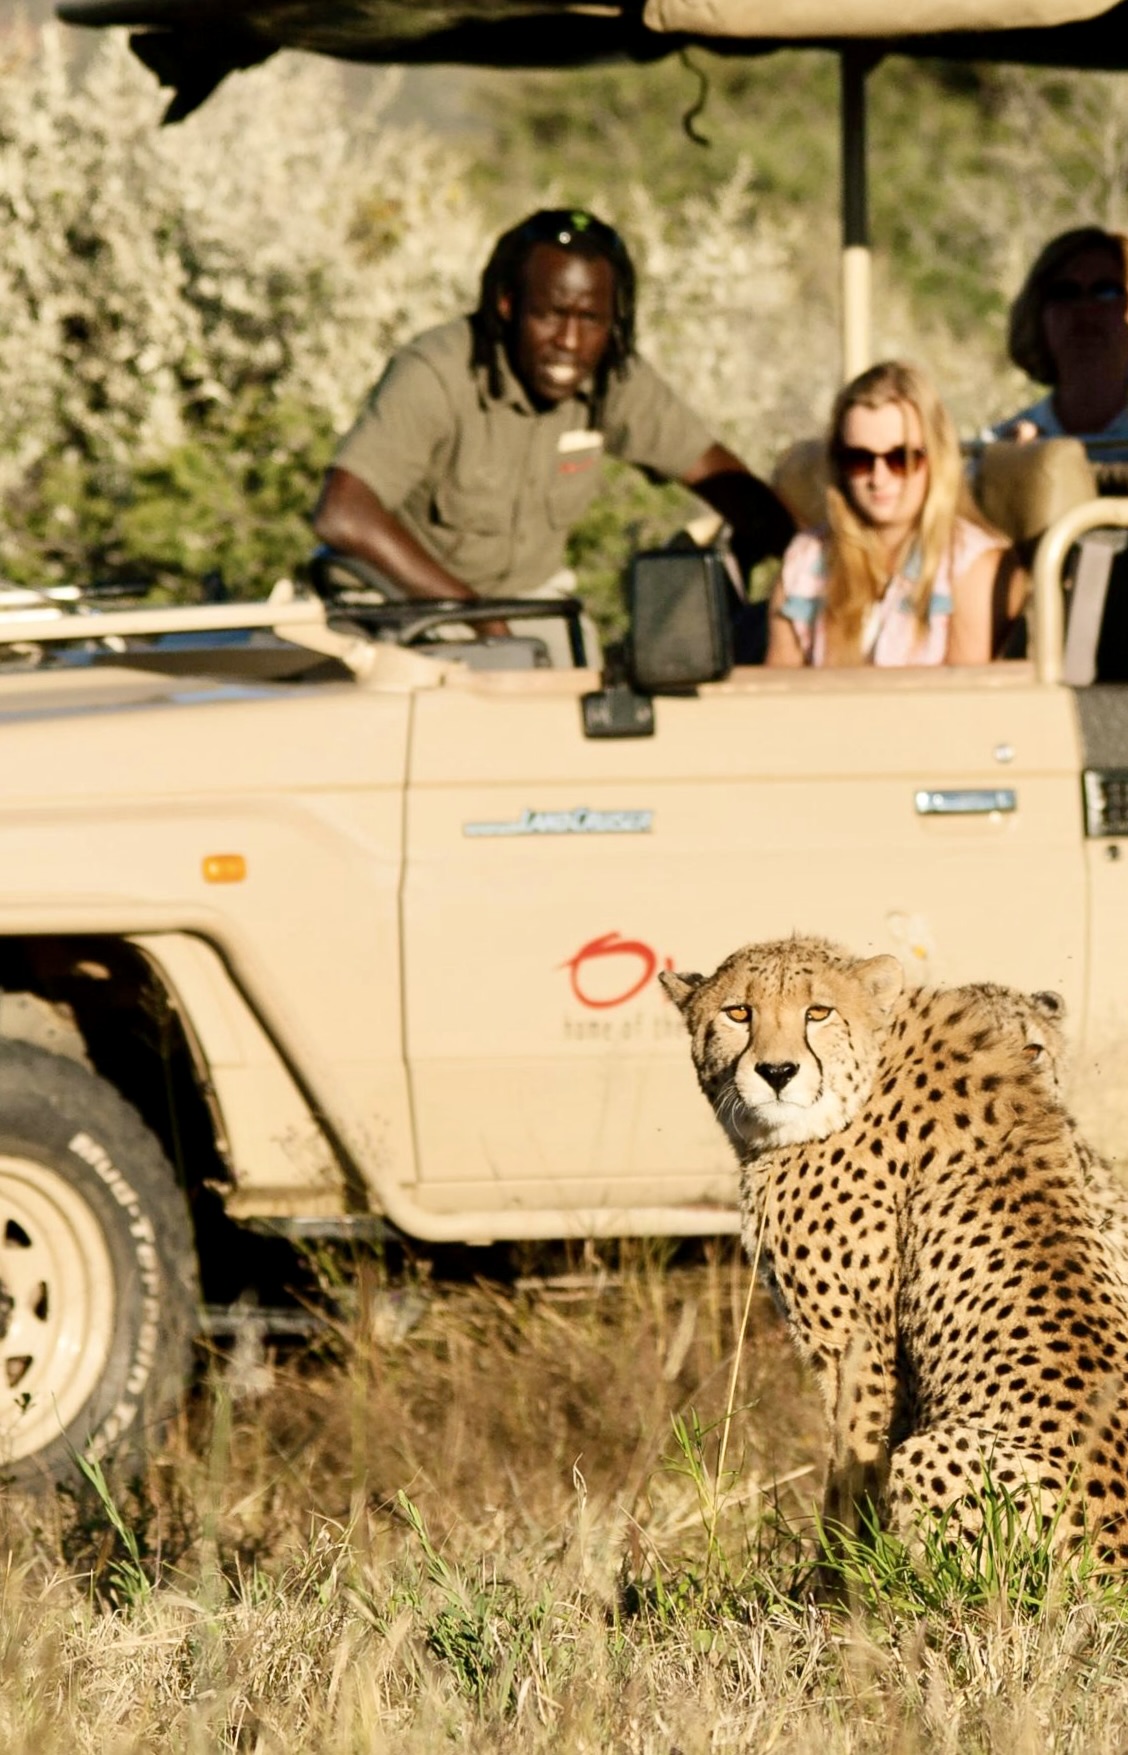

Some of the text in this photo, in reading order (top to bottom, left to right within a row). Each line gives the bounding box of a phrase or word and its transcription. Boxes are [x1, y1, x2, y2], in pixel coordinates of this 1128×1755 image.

[563, 1013, 612, 1041] home
[622, 1012, 645, 1041] of
[67, 1132, 160, 1395] Mud-Terrain
